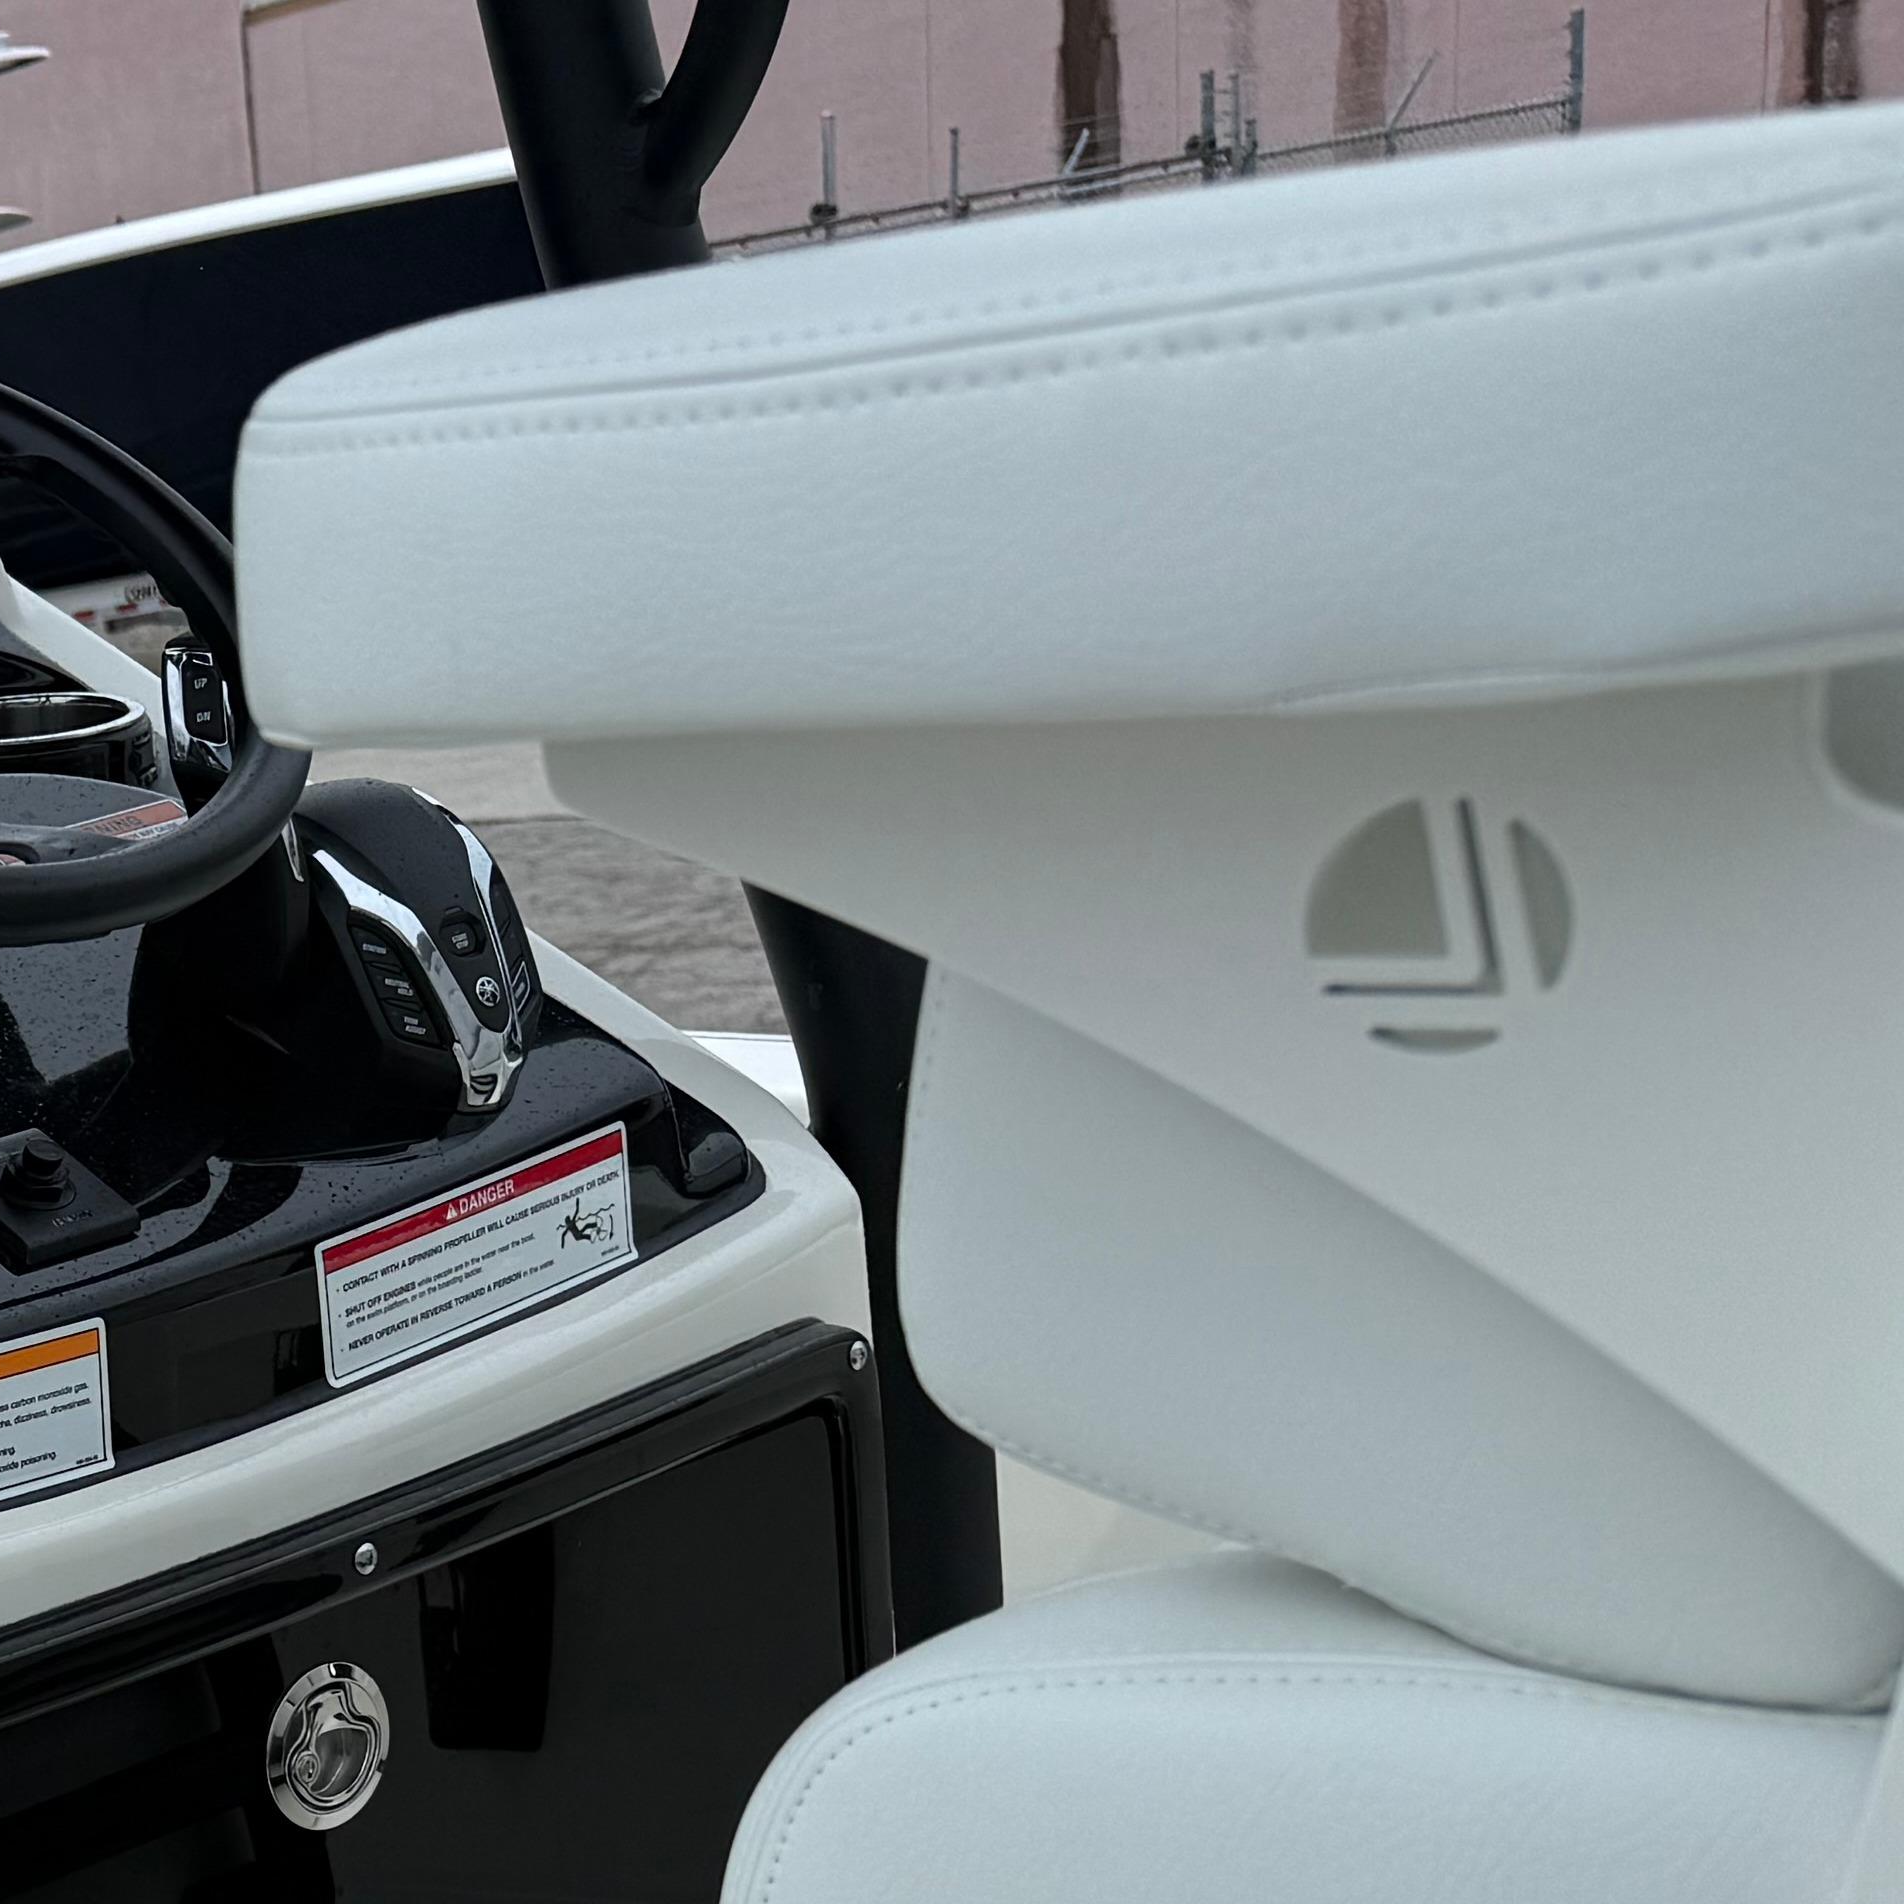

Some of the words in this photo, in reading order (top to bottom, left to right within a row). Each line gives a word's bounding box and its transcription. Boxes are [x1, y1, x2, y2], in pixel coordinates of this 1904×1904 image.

[194, 677, 208, 690] UP
[458, 1178, 514, 1214] DANGER
[342, 1270, 378, 1292] CONTACT
[380, 1262, 399, 1276] WITH
[400, 1258, 406, 1269] A
[407, 1244, 442, 1265] SPINNING
[443, 1226, 486, 1250] PROPELLER
[486, 1218, 504, 1232] WILL
[504, 1208, 528, 1225] CAUSE
[529, 1195, 560, 1214] SERIOUS
[560, 1185, 584, 1201] INJURY
[585, 1179, 596, 1191] OR
[344, 1301, 366, 1317] SHUT
[366, 1295, 382, 1308] OFF
[382, 1281, 416, 1301] ENGINES
[348, 1333, 373, 1350] NEVER
[374, 1318, 409, 1339] OPERATE
[410, 1313, 418, 1325] IN
[419, 1300, 453, 1320] REVERSE
[454, 1286, 485, 1306] TOWARD
[492, 1270, 522, 1289] PERSON
[9, 1395, 36, 1409] carbon
[37, 1385, 72, 1402] monoxide
